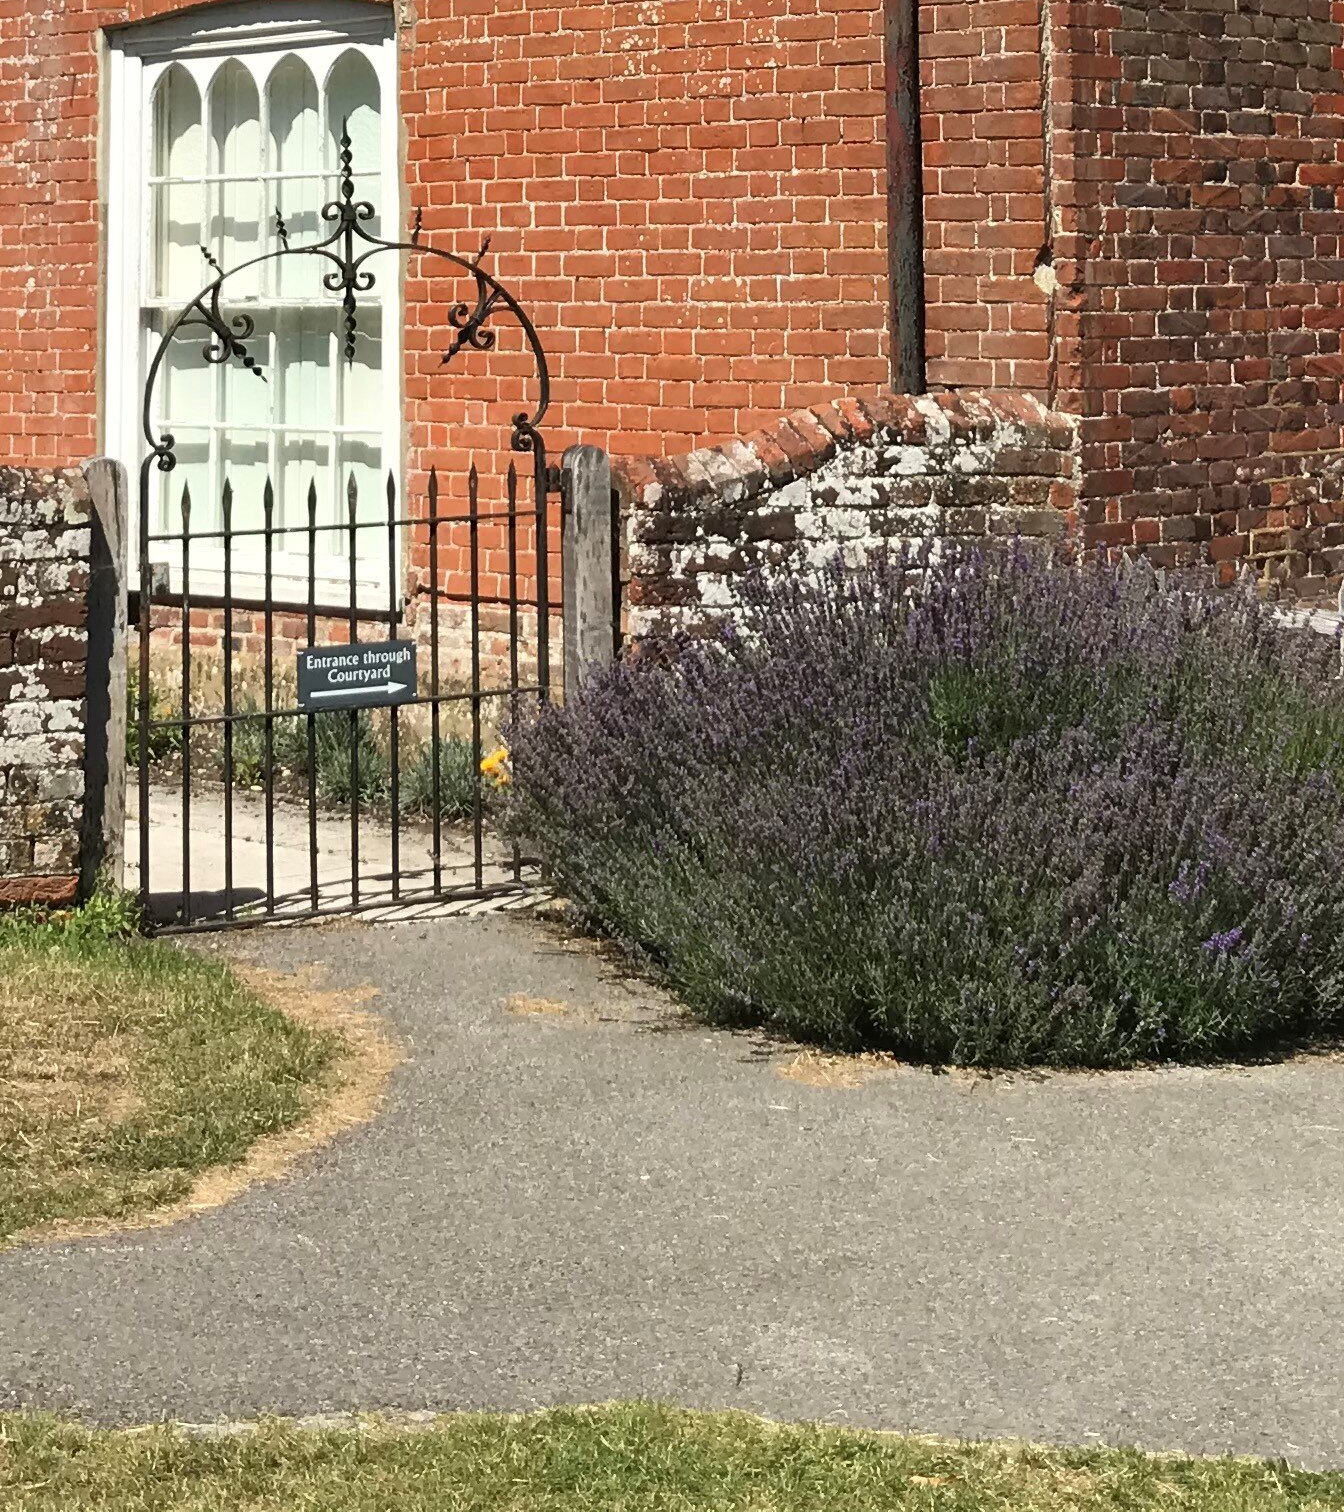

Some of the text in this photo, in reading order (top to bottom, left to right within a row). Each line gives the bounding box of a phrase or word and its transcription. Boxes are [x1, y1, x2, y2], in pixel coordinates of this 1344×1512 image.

[306, 647, 411, 669] Entrance through
[327, 664, 391, 683] Courtyard
